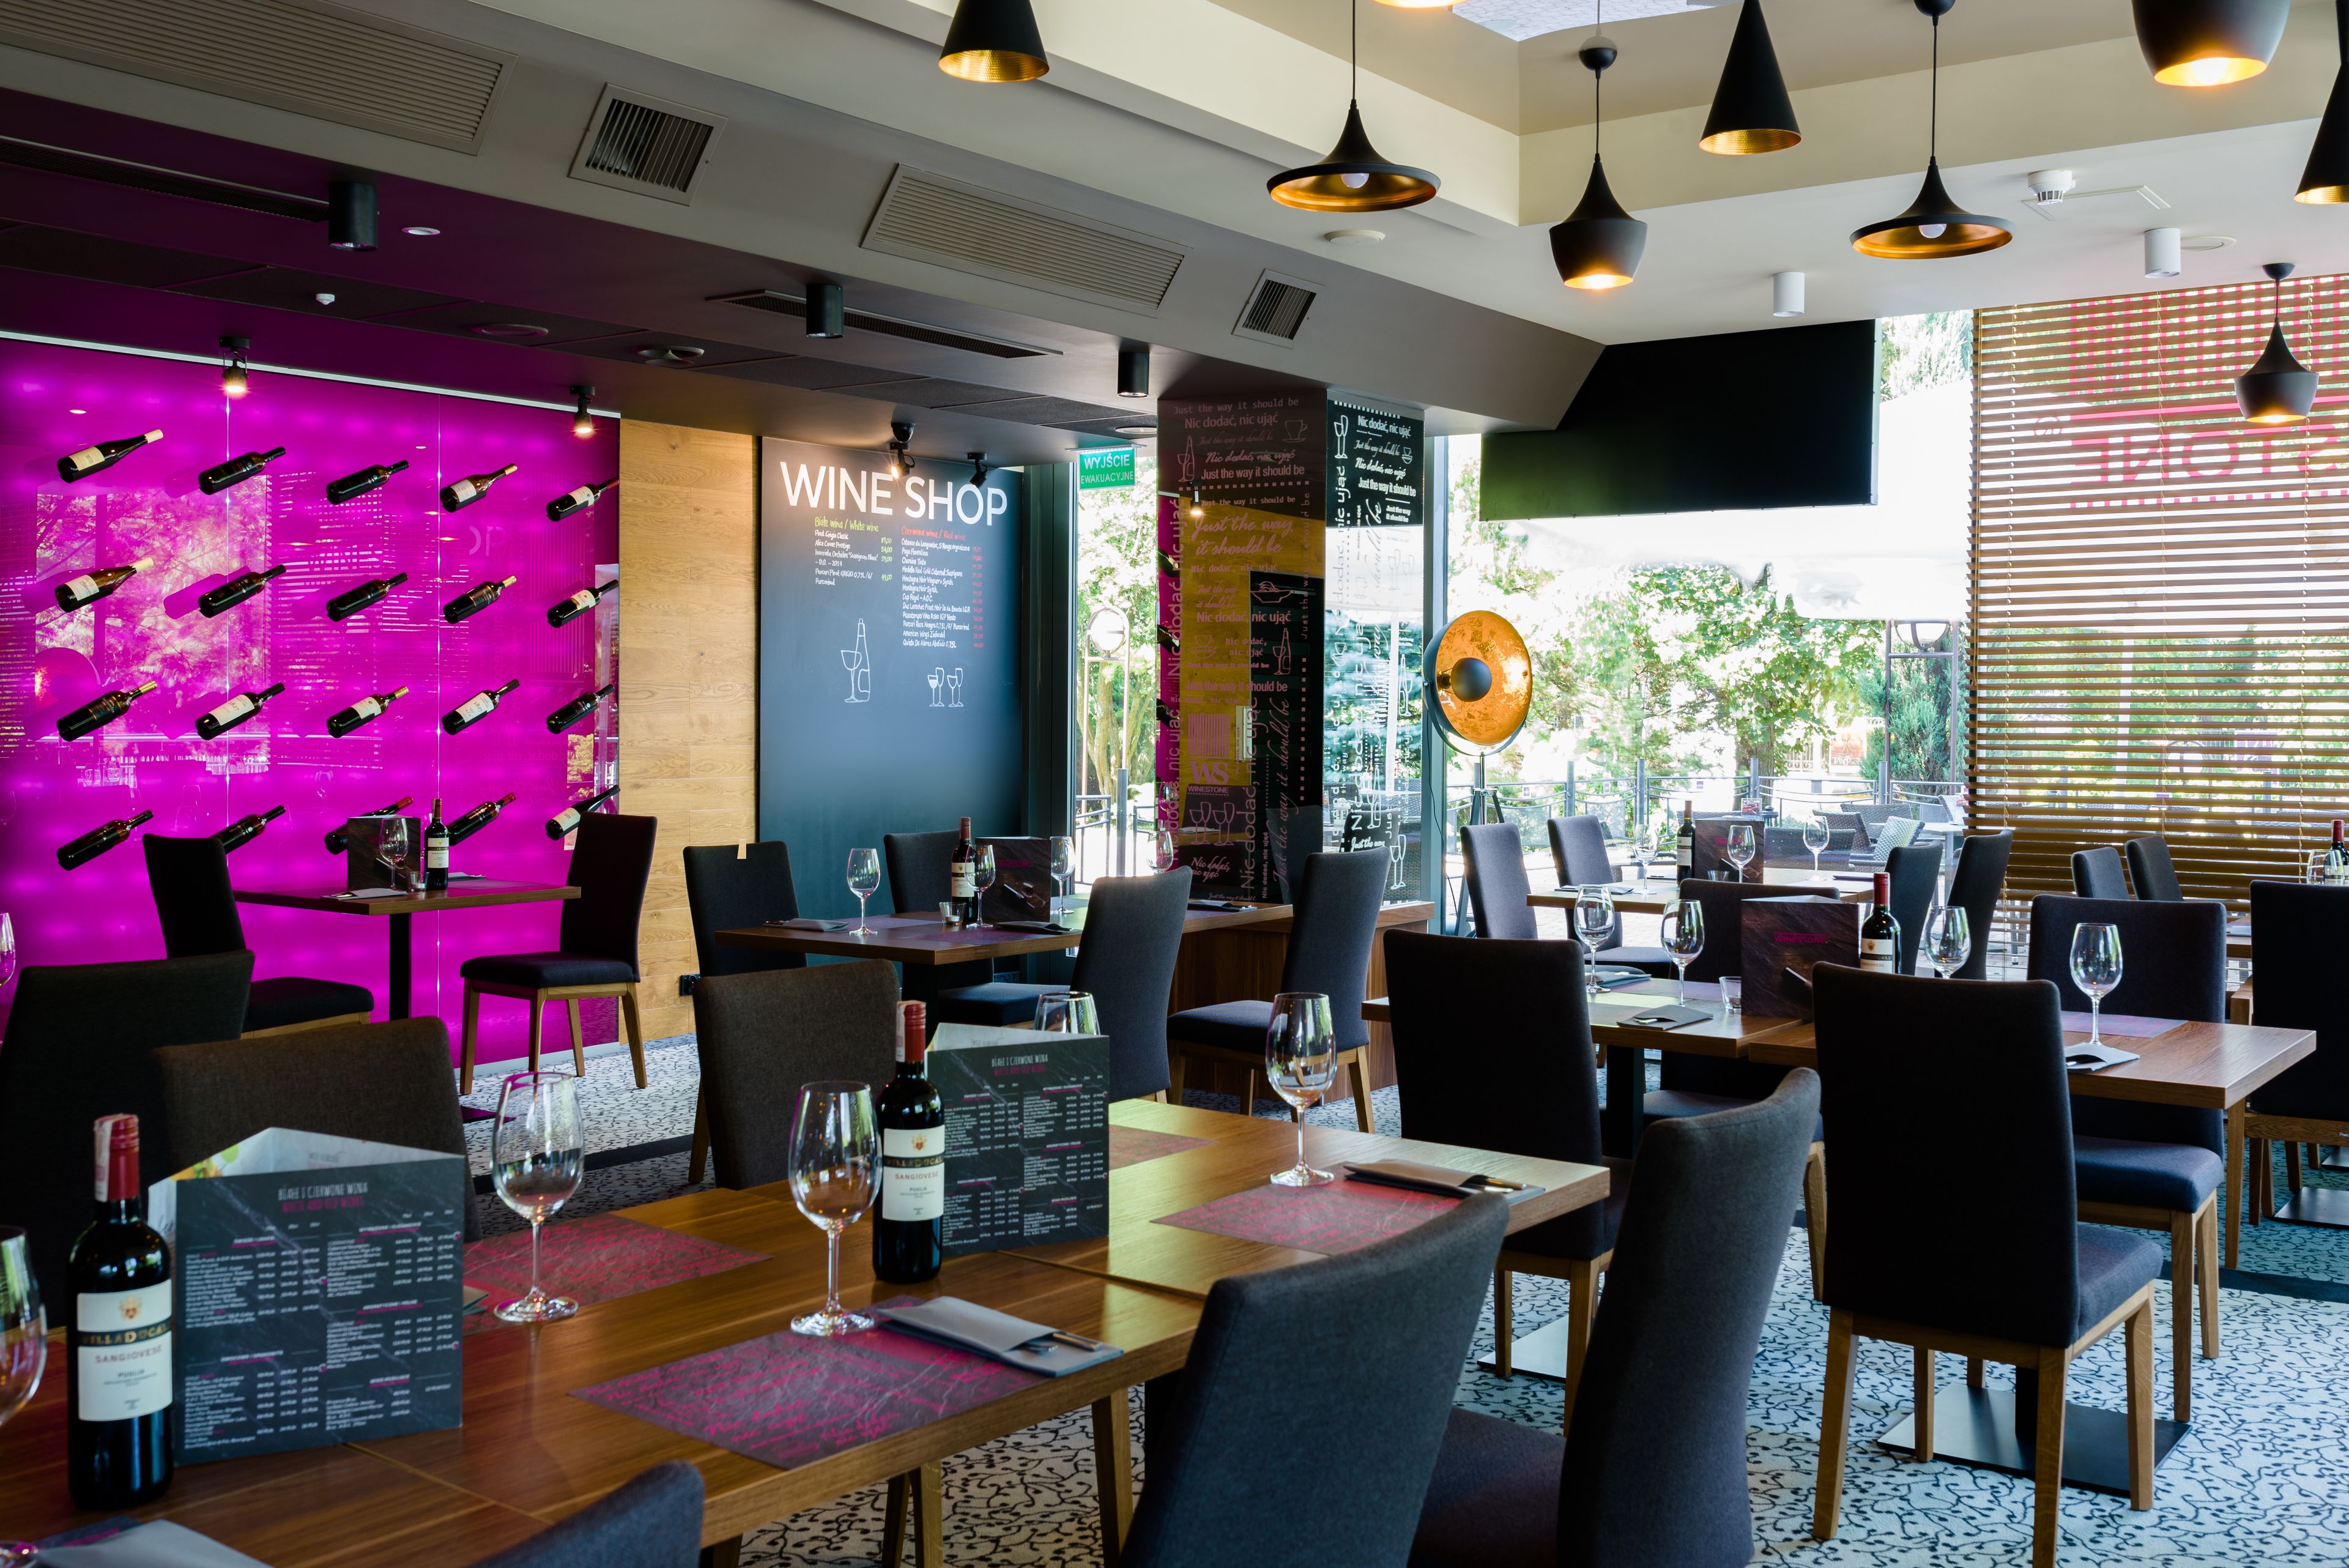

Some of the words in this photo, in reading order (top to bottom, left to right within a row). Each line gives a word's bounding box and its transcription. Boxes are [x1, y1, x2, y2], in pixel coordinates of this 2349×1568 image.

[1174, 406, 1193, 415] Just
[1198, 404, 1213, 413] the
[1217, 403, 1233, 412] way
[1238, 401, 1248, 411] it
[1252, 398, 1283, 409] should
[1288, 397, 1299, 406] be
[1184, 417, 1201, 429] Nic
[1203, 415, 1238, 428] dodać,
[1239, 414, 1255, 426] nic
[1257, 411, 1280, 426] ująć
[1357, 415, 1368, 427] Nic
[1368, 417, 1389, 434] dodać,
[1389, 423, 1398, 434] nic
[1399, 426, 1411, 439] ująć
[1084, 453, 1130, 470] WYJŚCIE
[1201, 468, 1219, 480] Just
[1220, 467, 1234, 479] the
[1236, 469, 1253, 480] way
[1255, 466, 1261, 477] it
[1263, 464, 1291, 477] should
[1293, 464, 1305, 475] be
[1081, 470, 1134, 484] EWAKUACYJNE
[1358, 477, 1370, 489] Just
[1370, 478, 1378, 490] the
[1379, 482, 1389, 495] way
[1389, 481, 1393, 494] it
[1393, 483, 1409, 496] should
[1409, 486, 1417, 497] be
[780, 461, 894, 516] WINE
[905, 475, 1008, 526] SHOP
[1365, 499, 1382, 524] be
[830, 518, 843, 530] wina
[850, 519, 865, 531] White
[866, 522, 879, 532] wine
[1191, 513, 1230, 541] Just
[1230, 512, 1256, 532] the
[1261, 520, 1293, 538] way
[1196, 540, 1212, 555] it
[1212, 535, 1263, 555] should
[1266, 533, 1283, 554] be
[1197, 611, 1213, 623] Nic
[1215, 610, 1249, 624] dodać,
[1252, 611, 1268, 622] nic
[1269, 610, 1292, 625] ująć
[1187, 680, 1203, 692] Just
[1204, 680, 1219, 691] the
[1220, 682, 1236, 694] way
[1238, 680, 1244, 691] it
[1246, 680, 1274, 692] should
[1277, 681, 1288, 692] be
[1269, 697, 1290, 715] be
[1242, 697, 1269, 738] ująć
[1267, 710, 1290, 769] should
[1240, 745, 1256, 773] nic
[1189, 760, 1230, 785] WS
[1277, 773, 1288, 786] it
[1236, 781, 1260, 853] dodać,
[1279, 792, 1299, 822] way
[1266, 820, 1287, 849] the
[1239, 858, 1255, 889] Nic
[1272, 851, 1290, 891] Just
[895, 1170, 939, 1181] SANGIOVESE
[94, 1344, 162, 1364] SANGIOVESE
